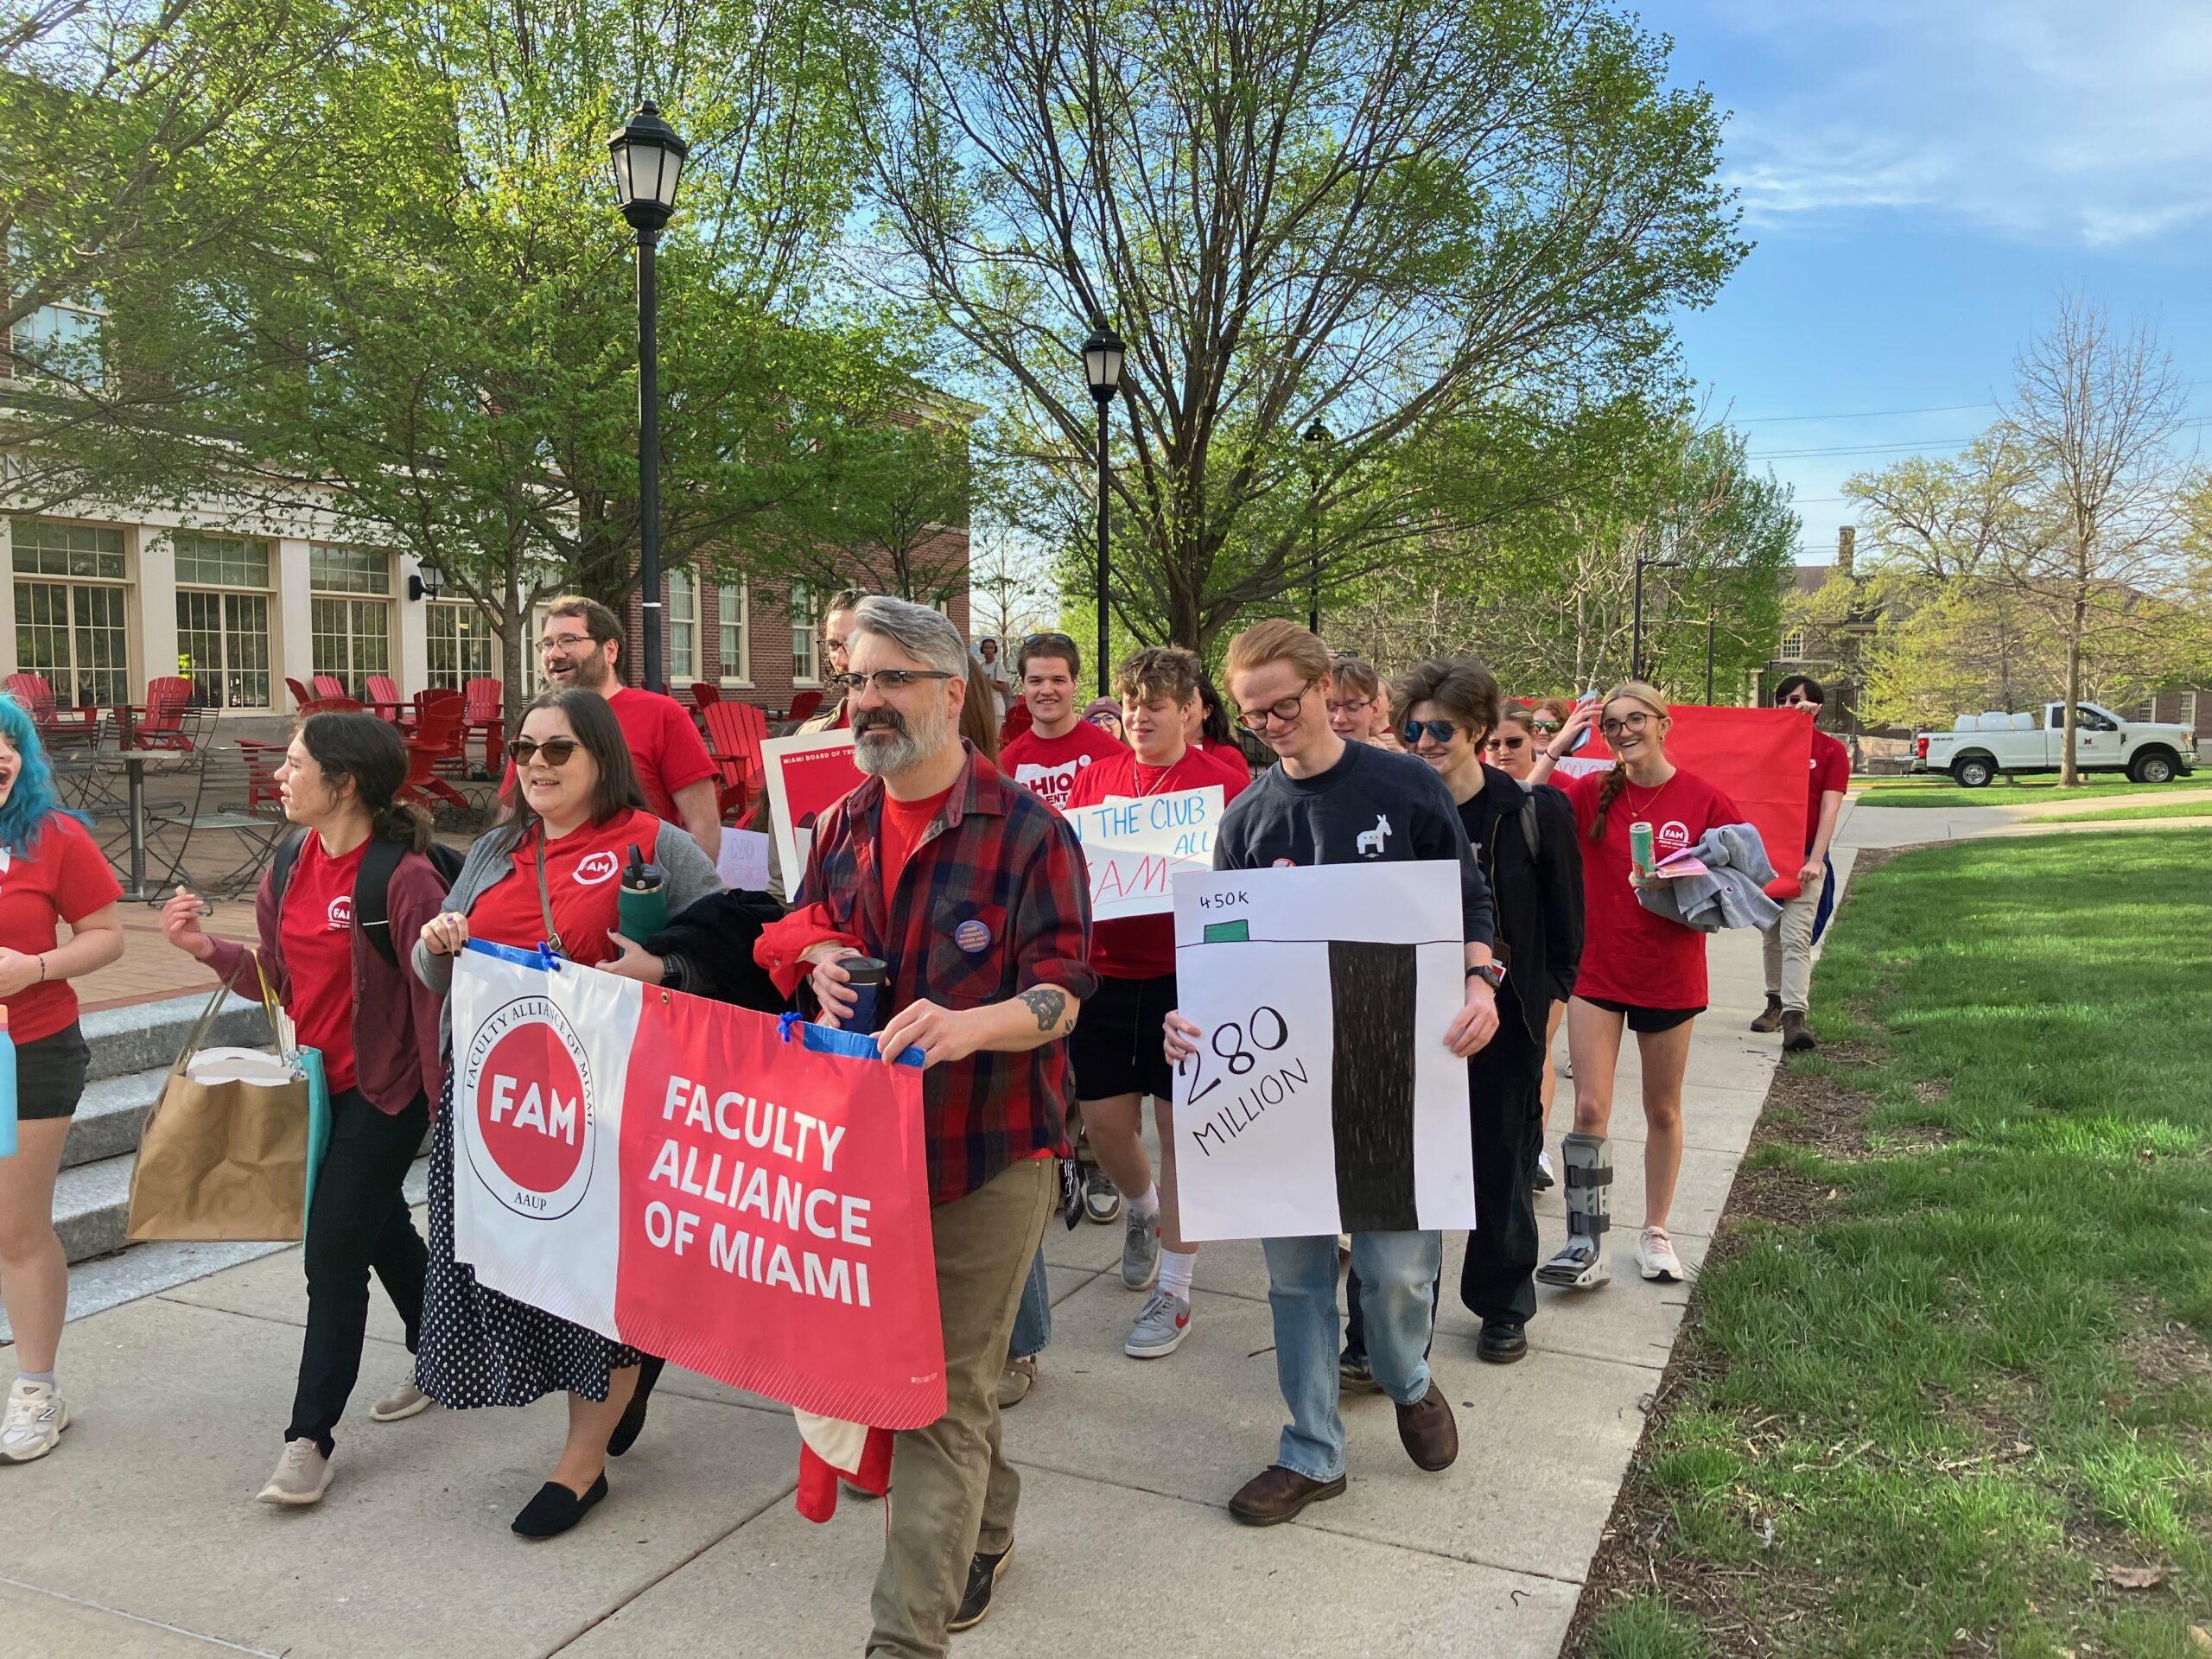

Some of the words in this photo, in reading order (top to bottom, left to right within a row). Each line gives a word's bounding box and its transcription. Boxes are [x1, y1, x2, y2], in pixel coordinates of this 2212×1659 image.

[783, 756, 804, 765] MIAMI
[805, 752, 830, 761] BOARD
[1020, 772, 1074, 795] HIO
[1092, 803, 1143, 838] THE
[1151, 796, 1205, 830] CLUB
[1664, 830, 1684, 840] FAM
[731, 838, 754, 860] NO
[1174, 830, 1212, 855] ALL
[1199, 891, 1249, 908] 450K
[467, 1013, 507, 1090] FACULTY
[512, 1001, 565, 1034] ALLIANCE
[566, 1033, 582, 1056] OF
[580, 1061, 594, 1126] MIAMI
[1179, 1006, 1288, 1105] 280
[490, 1073, 577, 1147] FAM
[663, 1074, 847, 1173] FACULTY
[1192, 1058, 1308, 1156] MILLION
[514, 1192, 548, 1211] AAUP
[648, 1138, 872, 1247] ALLIANCE
[645, 1200, 701, 1256] OF
[709, 1223, 872, 1308] MIAMI
